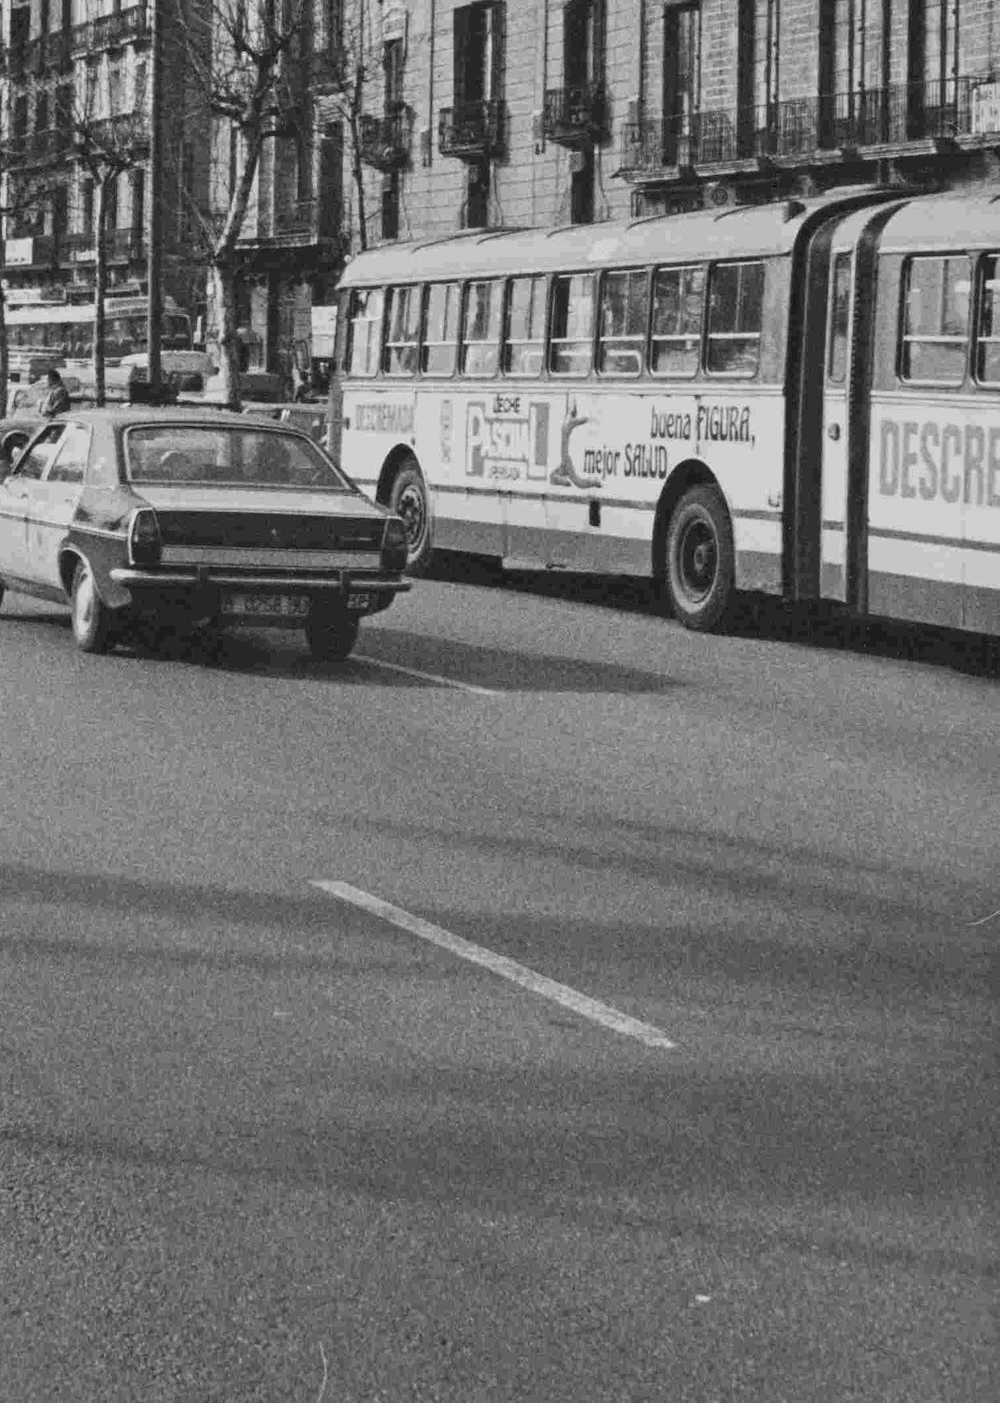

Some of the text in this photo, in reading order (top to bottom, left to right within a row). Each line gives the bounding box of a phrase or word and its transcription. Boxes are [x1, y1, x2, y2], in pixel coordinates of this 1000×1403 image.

[493, 395, 521, 413] LECHE
[650, 405, 756, 449] buena FIGURA,
[583, 443, 668, 480] mejor SALUD
